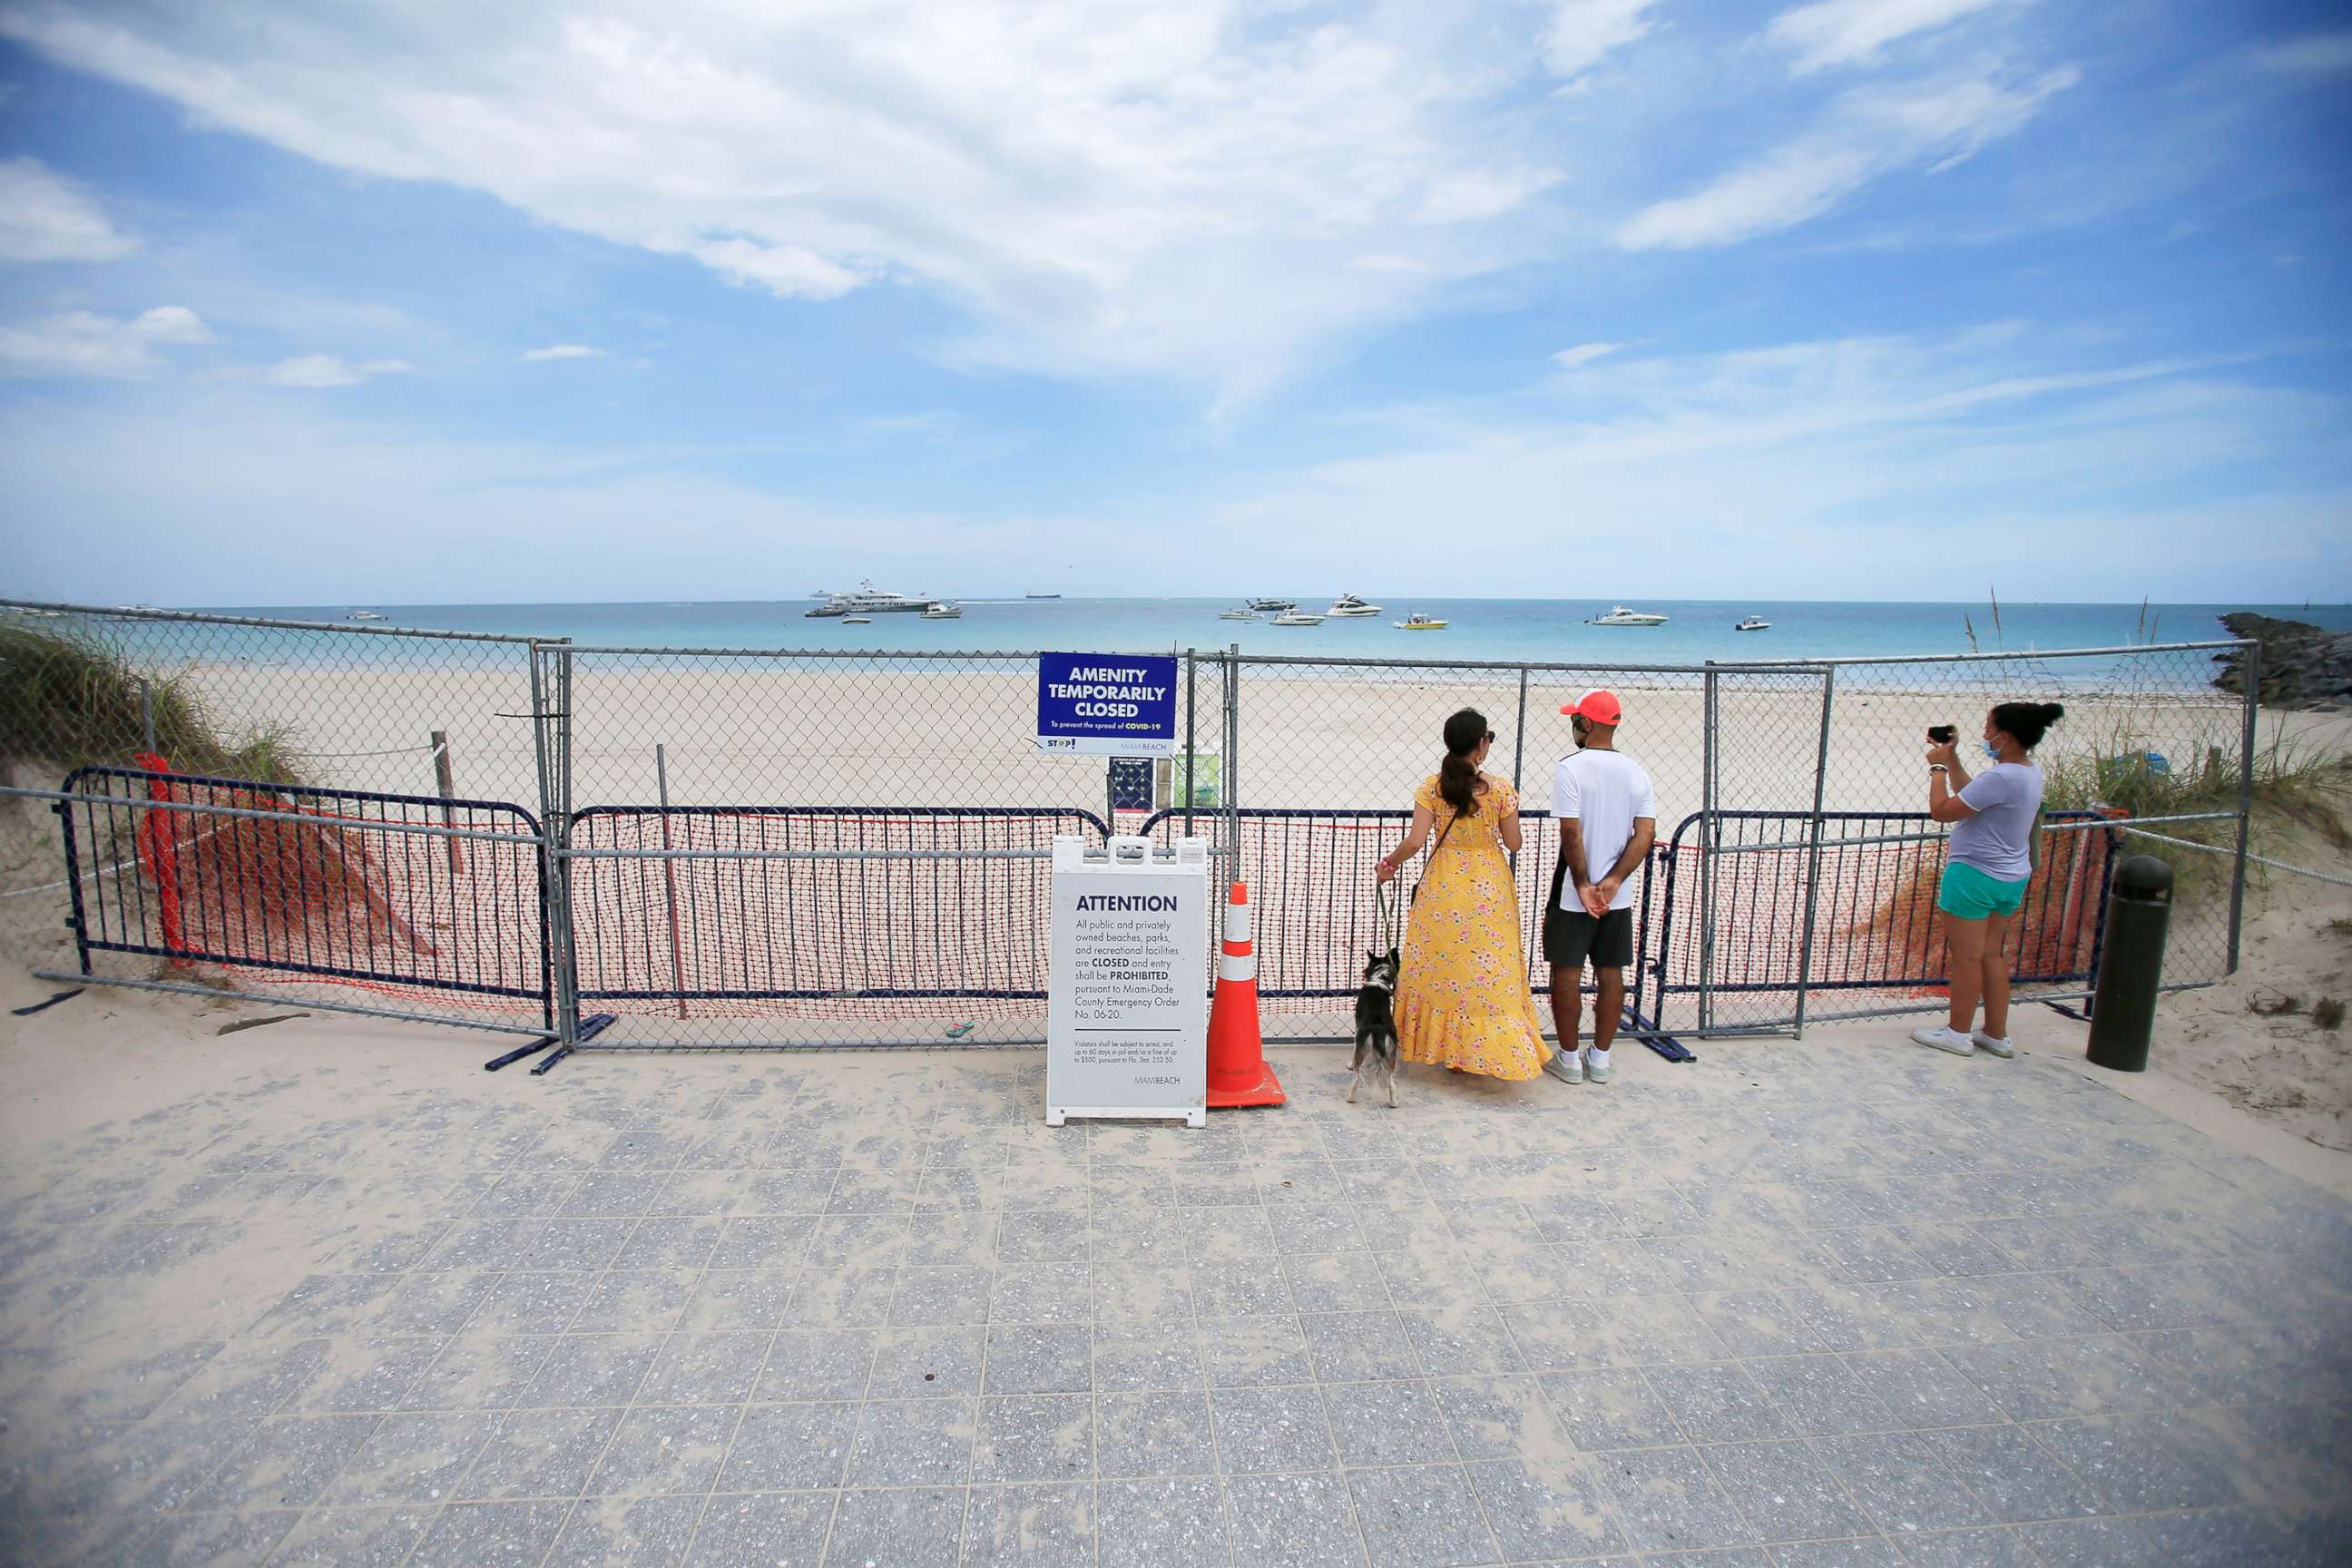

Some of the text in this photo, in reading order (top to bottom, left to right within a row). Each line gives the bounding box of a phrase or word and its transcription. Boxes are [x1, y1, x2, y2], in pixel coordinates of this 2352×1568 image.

[1069, 667, 1147, 682] AMENITY
[1049, 684, 1166, 701] TEMPORARILY
[1075, 702, 1138, 717] CLOSED
[1095, 722, 1115, 730] spread
[1076, 896, 1177, 911] ATTENTION
[1076, 919, 1171, 931] All public and privately
[1076, 933, 1171, 944] owned beaches, parks,
[1076, 946, 1179, 955] and recreational facilities
[1093, 958, 1129, 966] CLOSED
[1132, 958, 1148, 967] and
[1151, 960, 1171, 969] entry
[1075, 971, 1171, 981] shall be PROHIBITED,
[1075, 985, 1110, 995] pursuant
[1123, 985, 1173, 993] Miami-Dade
[1075, 997, 1180, 1008] County Emergency Order
[1075, 1010, 1122, 1019] No. 06-20.
